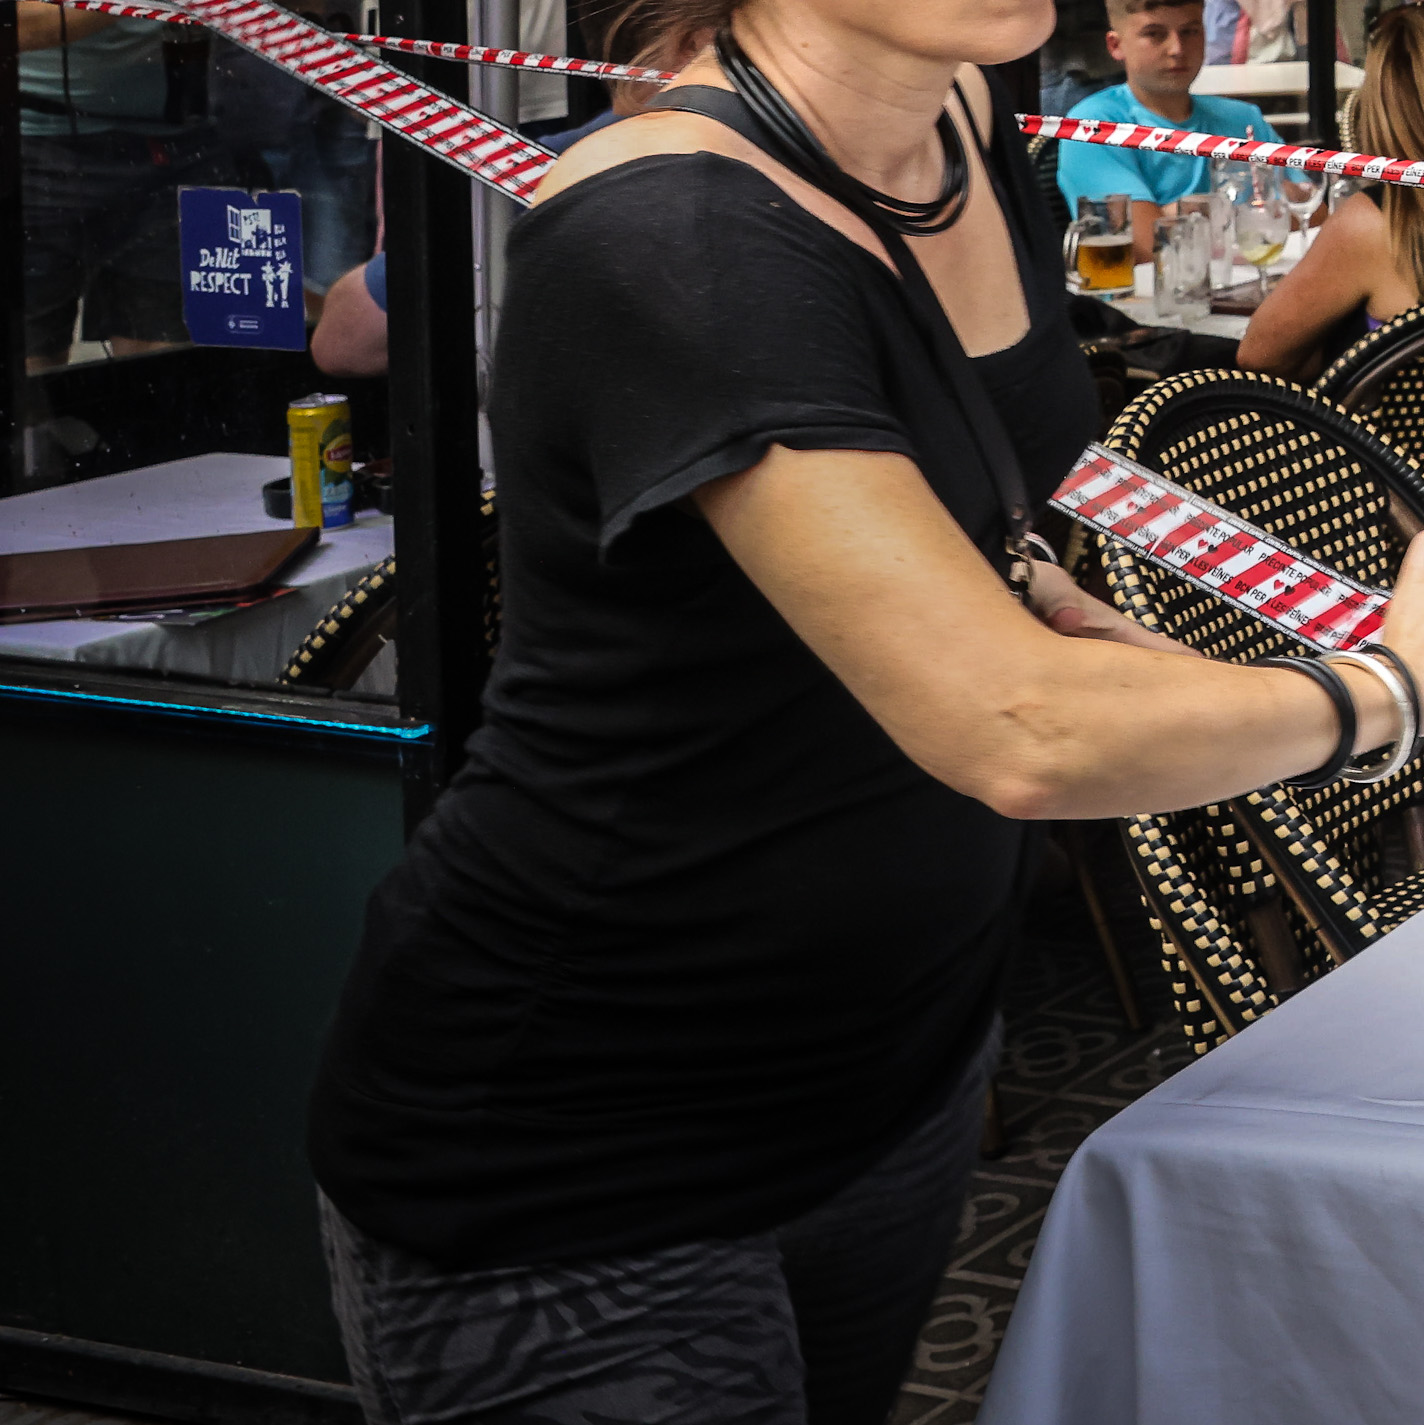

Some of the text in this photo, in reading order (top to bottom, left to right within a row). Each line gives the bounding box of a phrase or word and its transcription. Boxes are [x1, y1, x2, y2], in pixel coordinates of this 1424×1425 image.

[190, 271, 252, 295] RESPECT
[1219, 528, 1254, 555] POPULAR
[1259, 552, 1296, 578] PRECINTE
[1175, 547, 1191, 561] PER
[1234, 580, 1251, 594] BCN
[1250, 588, 1267, 603] PER
[1271, 599, 1288, 614] LES
